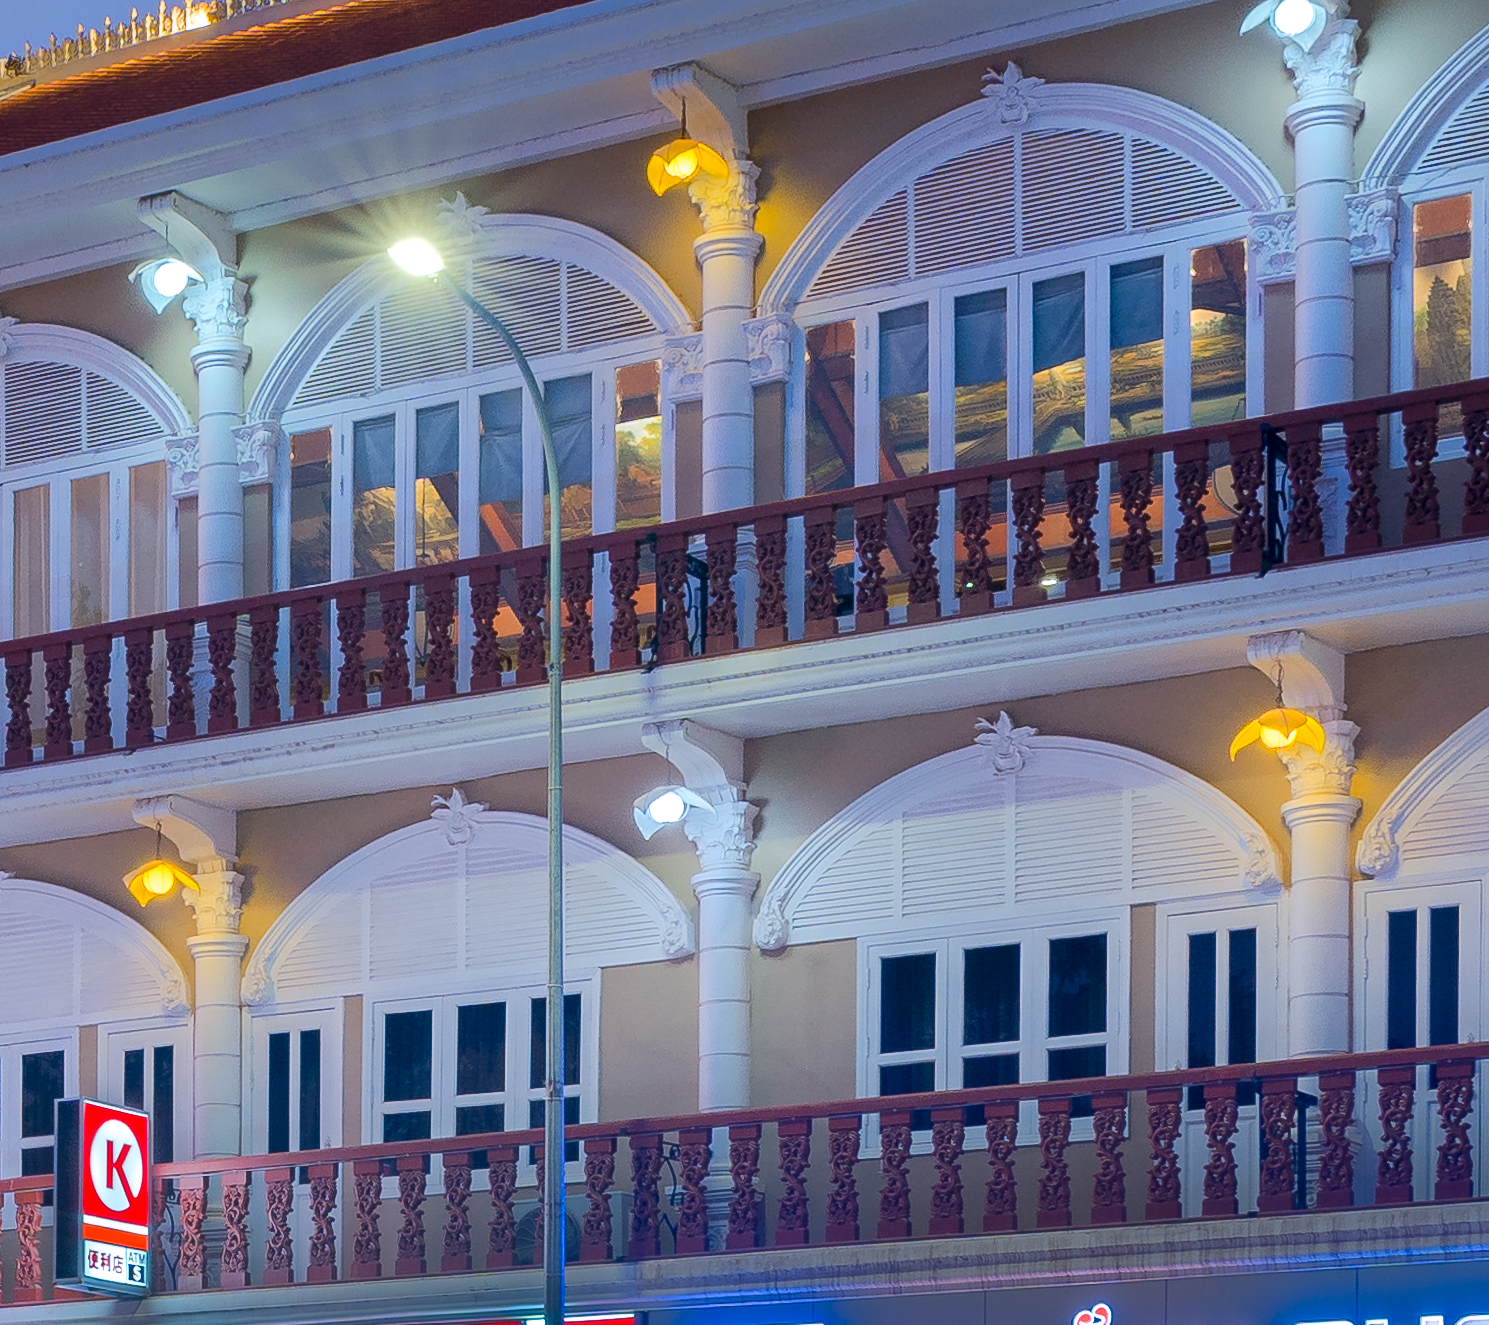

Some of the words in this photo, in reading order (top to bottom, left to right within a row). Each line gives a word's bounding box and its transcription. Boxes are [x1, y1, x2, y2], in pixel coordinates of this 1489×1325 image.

[99, 1131, 138, 1210] K
[88, 1249, 123, 1274] 便利店
[128, 1250, 145, 1264] ATM
